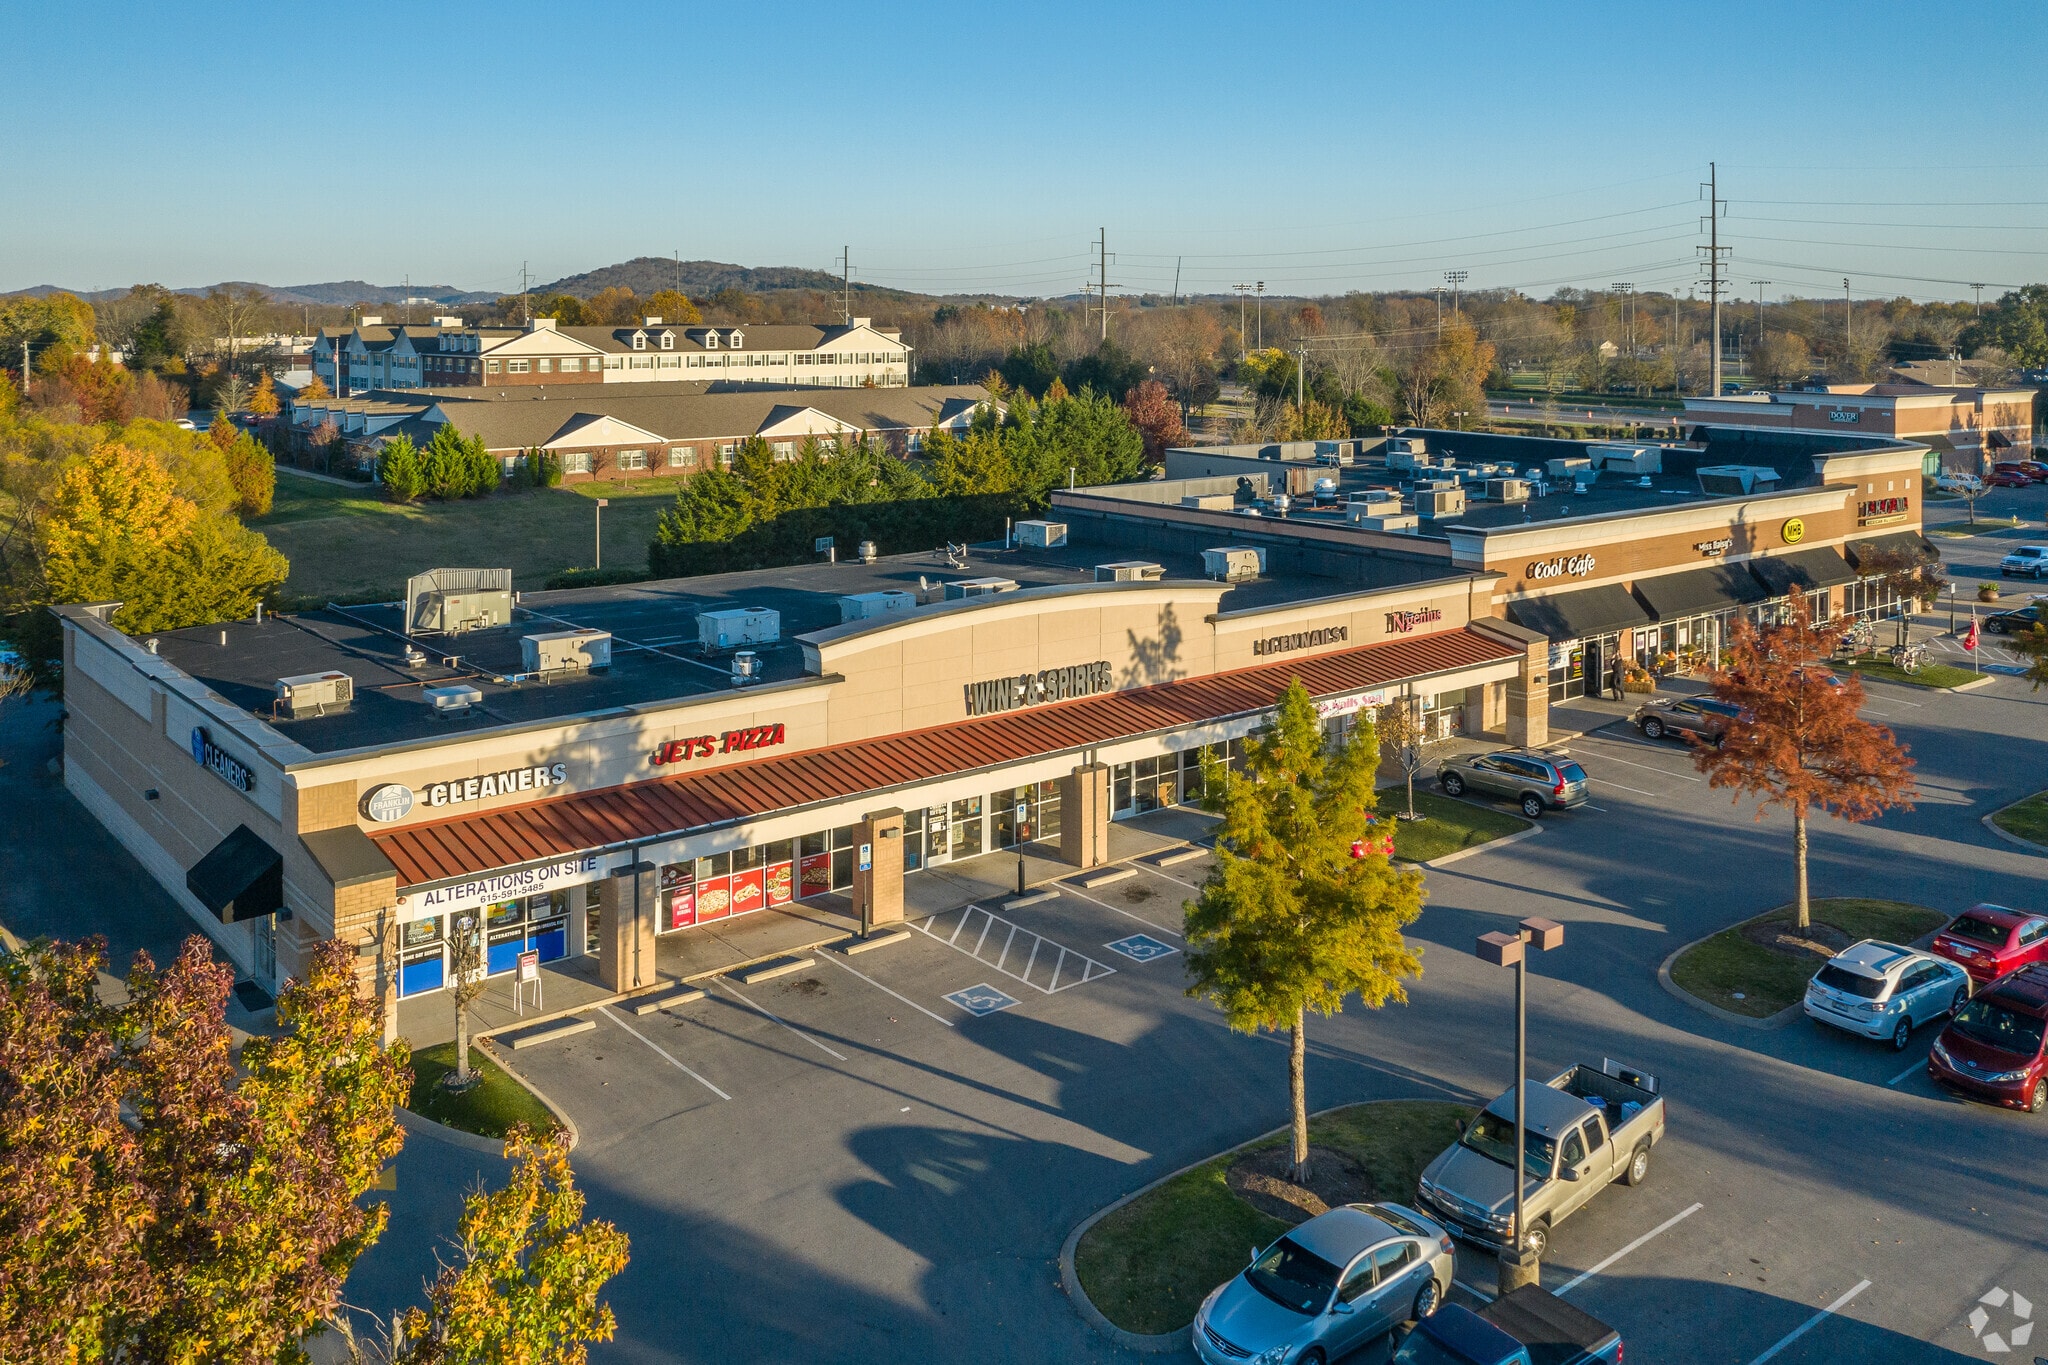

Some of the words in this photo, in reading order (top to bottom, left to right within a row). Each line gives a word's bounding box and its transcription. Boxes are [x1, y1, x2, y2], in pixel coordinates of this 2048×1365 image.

[1534, 558, 1562, 580] Cool
[1568, 554, 1595, 577] Cafe
[1301, 627, 1340, 649] NAILS
[974, 676, 1021, 716] WINE
[1027, 674, 1039, 706] &
[1046, 661, 1113, 703] SPIRITS
[655, 735, 717, 766] JET'S
[725, 723, 785, 754] PIZZA
[205, 743, 247, 792] CLEANERS
[430, 763, 568, 807] CLEANERS
[373, 796, 411, 811] FRANKLIN
[424, 869, 534, 907] ALTERATIONS
[538, 865, 560, 881] ON
[564, 857, 597, 875] SITE
[480, 883, 544, 904] 615-591-5485
[490, 929, 522, 941] ALTERATIONS
